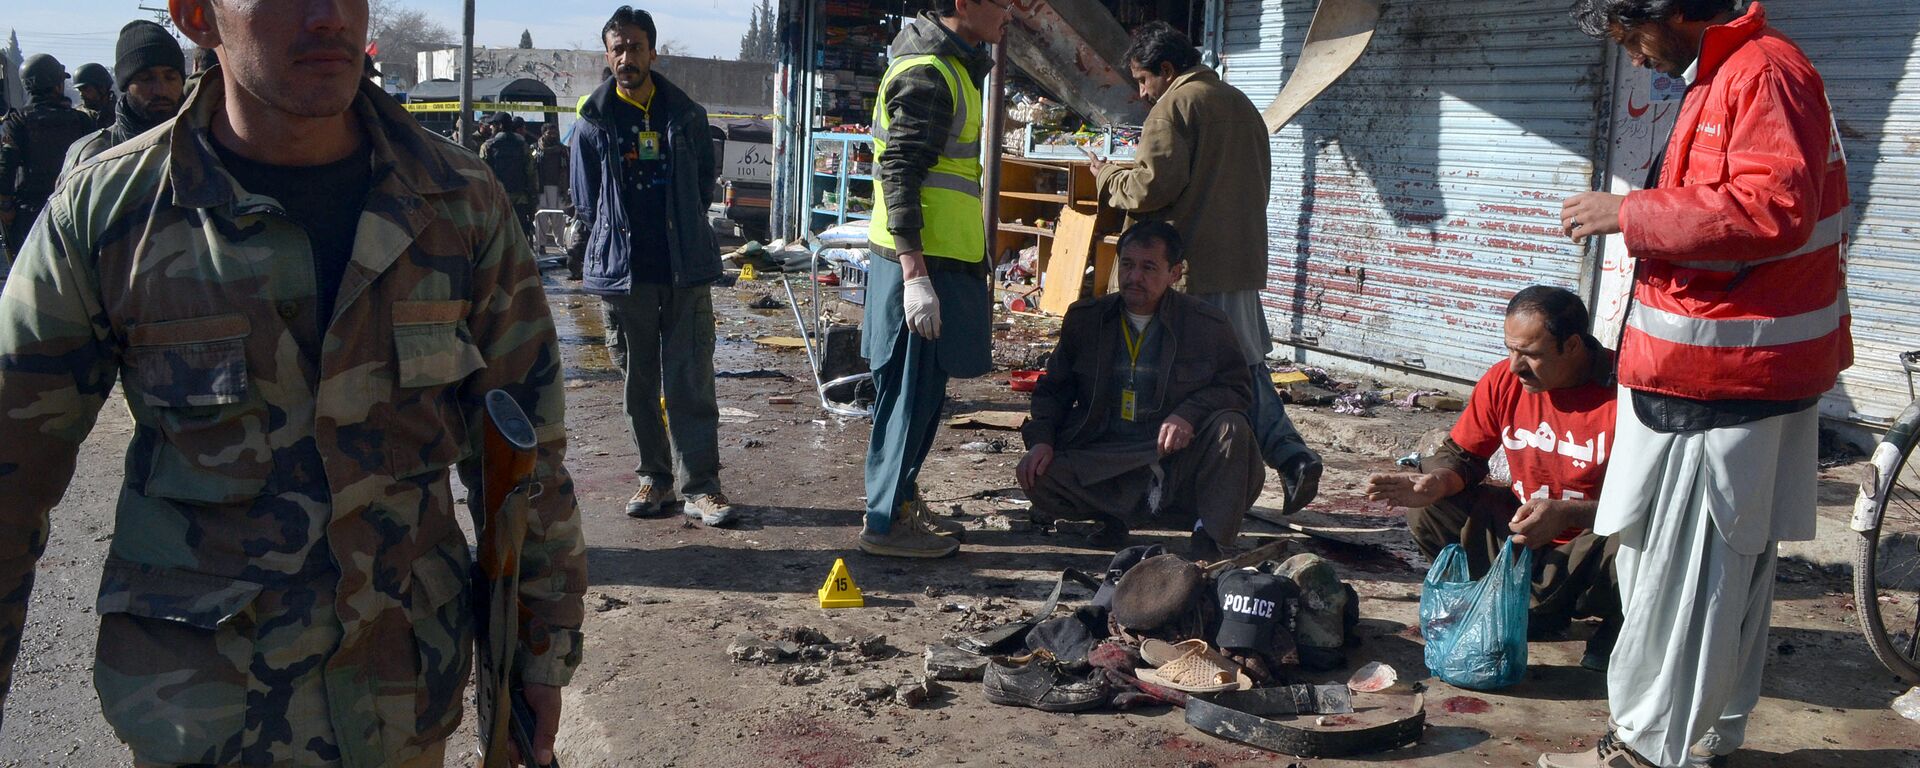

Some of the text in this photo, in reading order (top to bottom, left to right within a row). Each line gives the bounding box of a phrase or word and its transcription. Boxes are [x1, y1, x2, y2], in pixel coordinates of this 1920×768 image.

[743, 267, 751, 276] 12
[834, 578, 848, 592] 15
[1223, 593, 1275, 618] POLICE
